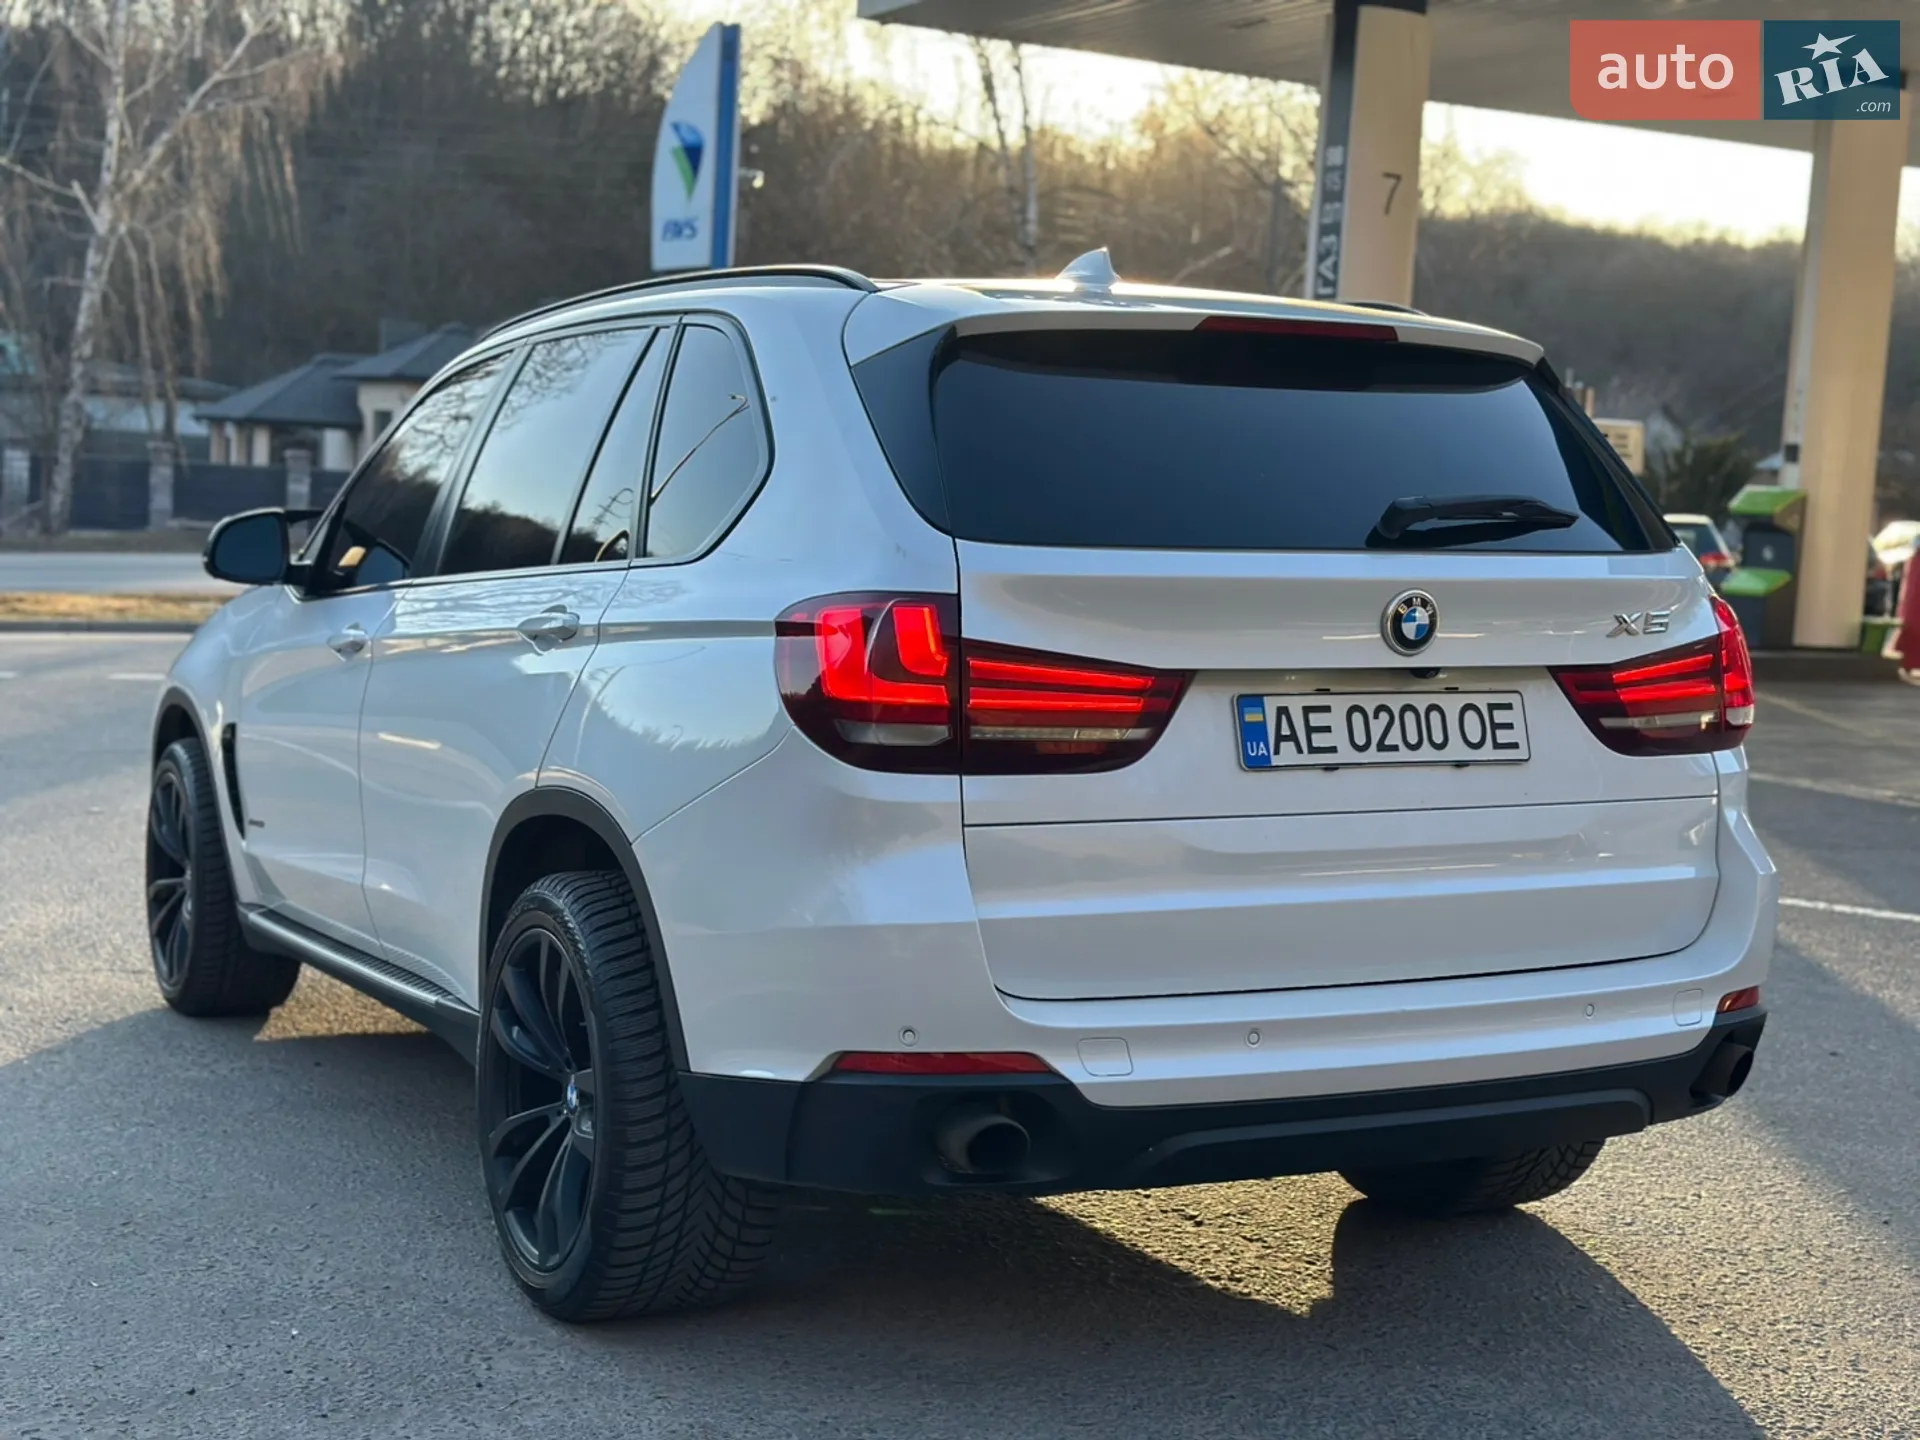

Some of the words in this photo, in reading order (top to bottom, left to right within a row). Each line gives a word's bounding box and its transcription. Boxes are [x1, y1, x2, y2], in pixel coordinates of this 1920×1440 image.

[1382, 171, 1403, 216] 7
[1397, 597, 1434, 615] BMW
[1606, 610, 1671, 638] X5
[1273, 705, 1338, 756] AE
[1346, 703, 1450, 753] 0200
[1458, 702, 1520, 751] OE
[1248, 741, 1269, 757] UA
